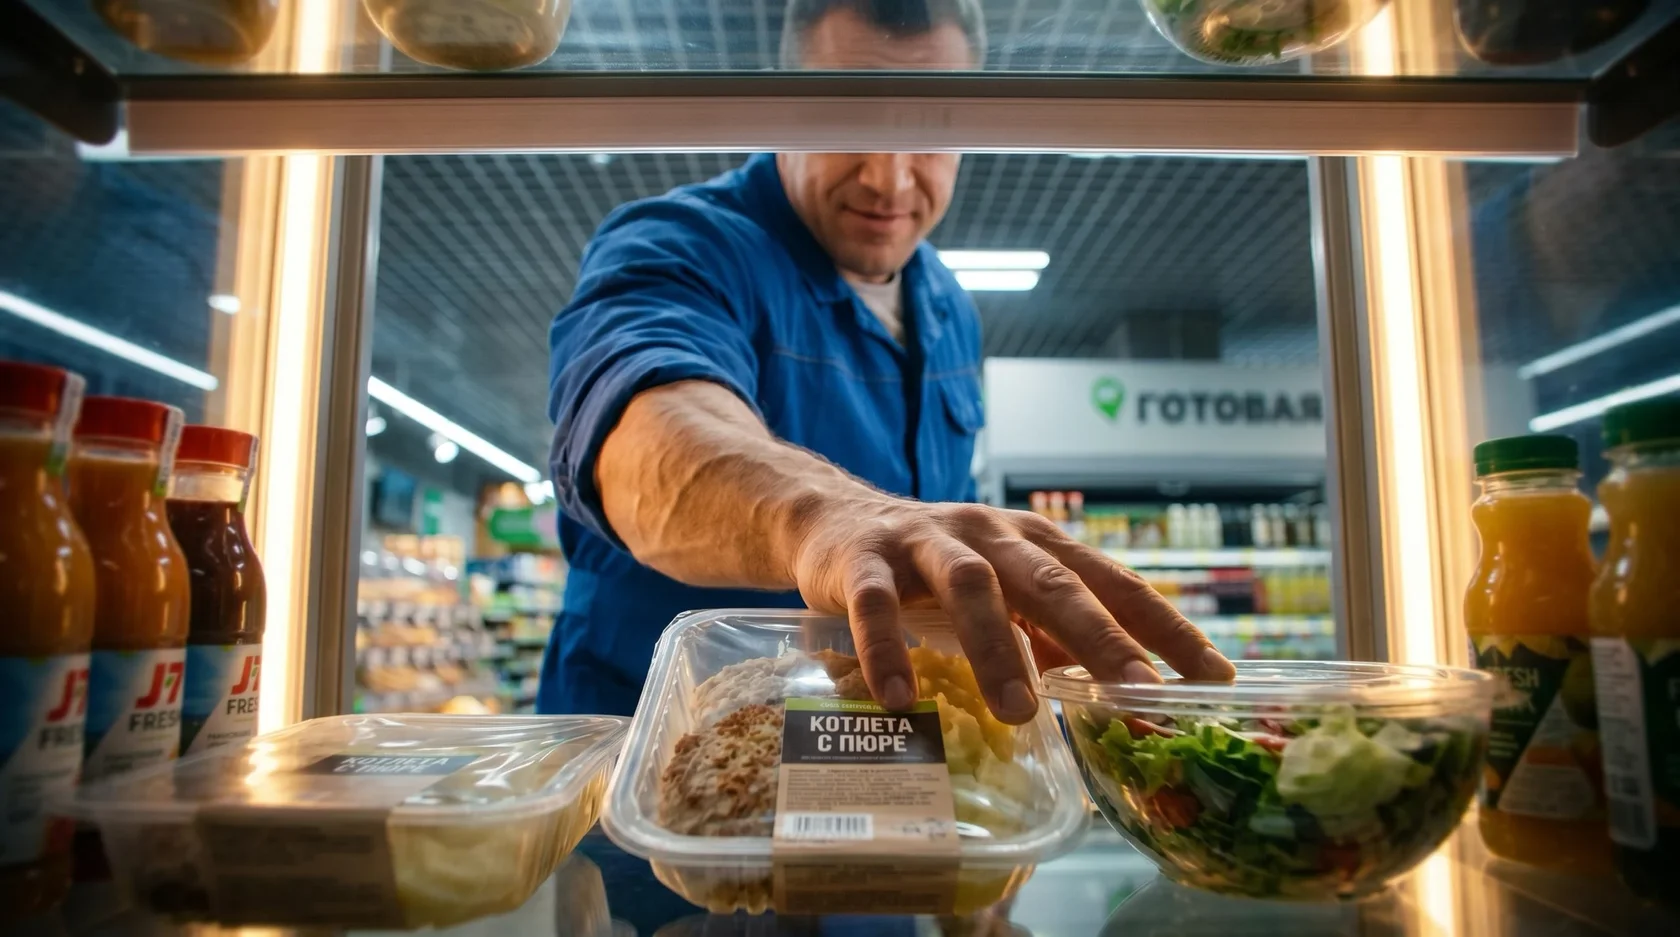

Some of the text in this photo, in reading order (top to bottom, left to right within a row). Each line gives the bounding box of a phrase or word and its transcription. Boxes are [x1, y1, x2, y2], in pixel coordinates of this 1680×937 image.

[1137, 391, 1323, 424] ГОТОВАЯ
[135, 662, 184, 708] J7
[231, 656, 261, 695] J7
[46, 669, 89, 722] J7
[129, 711, 180, 733] FRES
[810, 715, 914, 733] КОТЛЕТА
[817, 734, 907, 753] С ПЮРЕ
[340, 757, 450, 766] КОТЛЕТА
